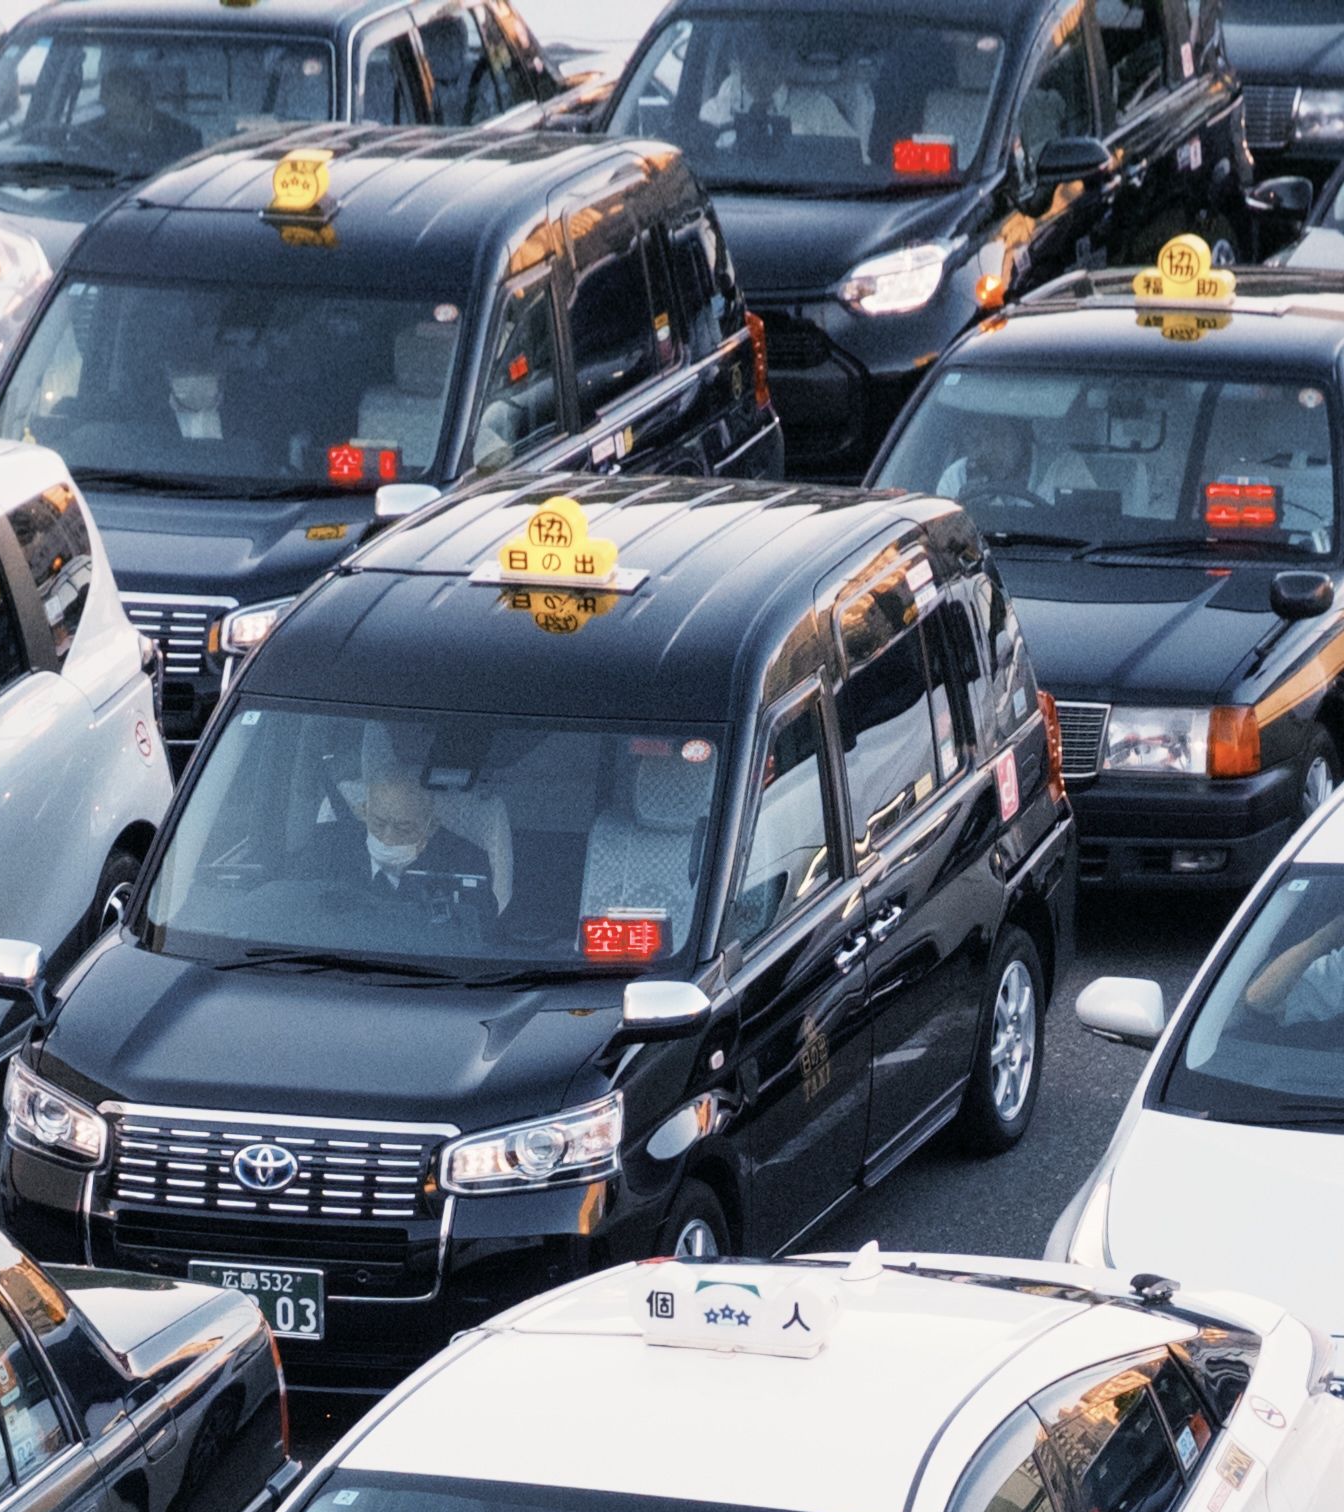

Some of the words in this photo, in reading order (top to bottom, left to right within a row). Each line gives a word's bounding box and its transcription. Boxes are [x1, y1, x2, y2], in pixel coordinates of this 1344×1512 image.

[1167, 248, 1194, 277] 協
[533, 518, 568, 546] 協
[508, 550, 595, 575] 日の出
[222, 1271, 294, 1292] 広島532
[646, 1290, 675, 1319] 個
[783, 1302, 811, 1332] 人
